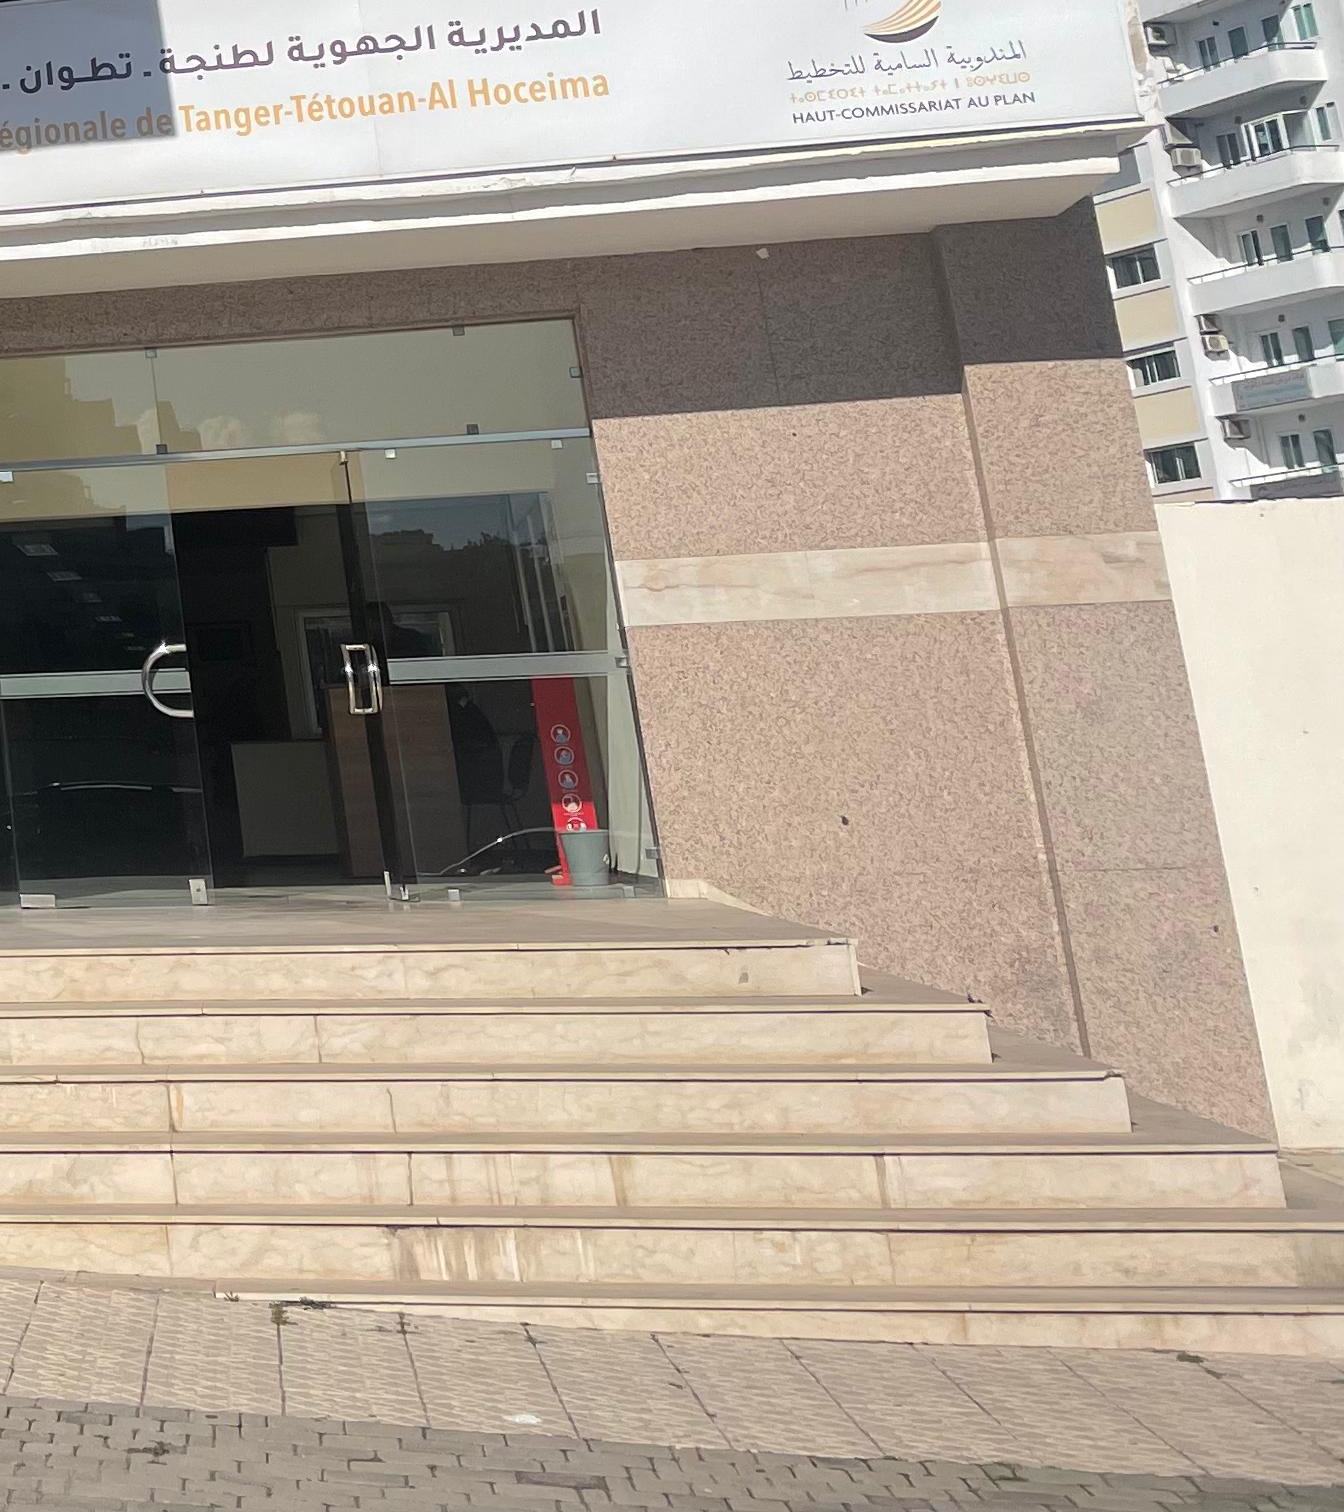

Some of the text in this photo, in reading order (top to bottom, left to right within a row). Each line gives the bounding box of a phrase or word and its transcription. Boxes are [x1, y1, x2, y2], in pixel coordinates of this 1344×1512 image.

[287, 25, 436, 69] الجهوية
[447, 8, 602, 54] المديرية
[19, 52, 134, 94] تطوان
[159, 41, 274, 81] لطنجة
[787, 40, 1027, 83] المندوبية السامية للتخطيط
[136, 107, 172, 137] de
[179, 80, 458, 137] Tanger-Tétouan-Al
[468, 71, 610, 107] Hoceima
[792, 92, 1035, 124] HAUT-COMMISSARIAT AU PLAN
